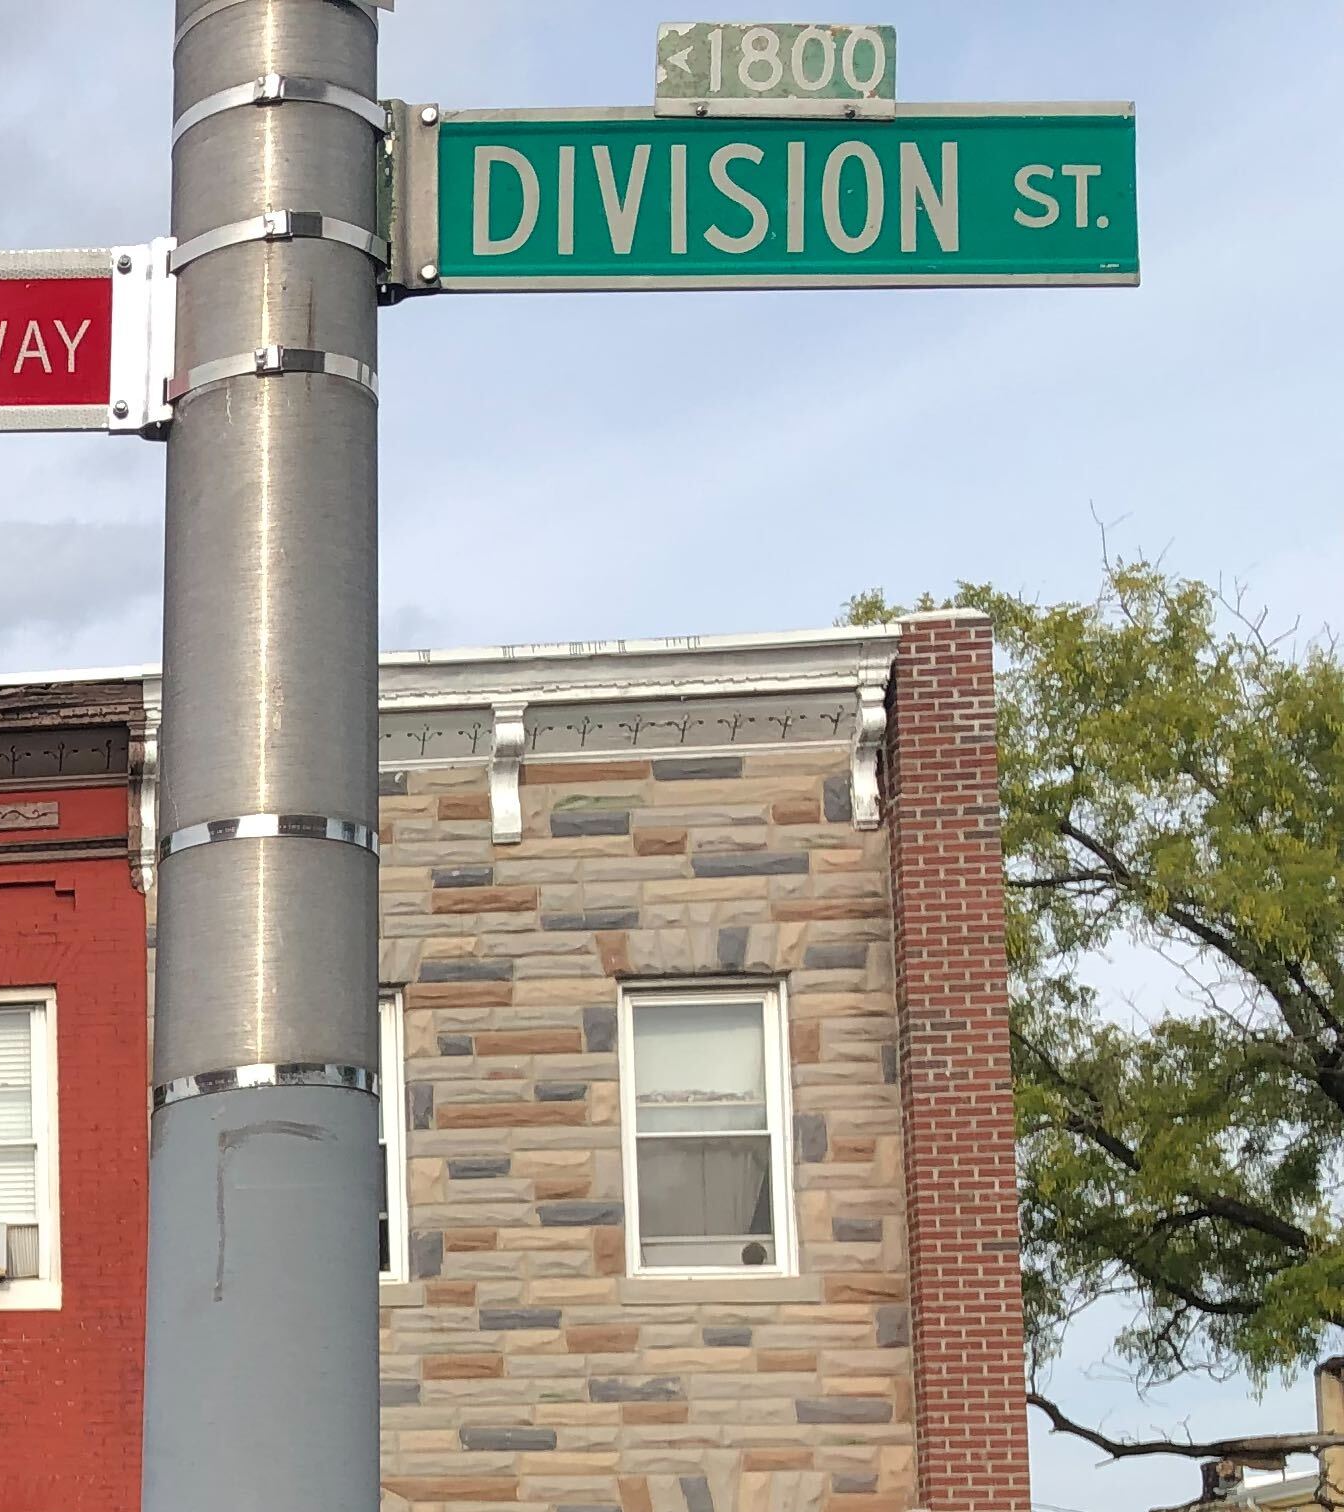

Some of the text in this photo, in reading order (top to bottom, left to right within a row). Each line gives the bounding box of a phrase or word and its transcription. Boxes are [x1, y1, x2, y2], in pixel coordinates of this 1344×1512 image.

[708, 27, 887, 94] 1800
[472, 139, 1111, 257] DIVISION ST.
